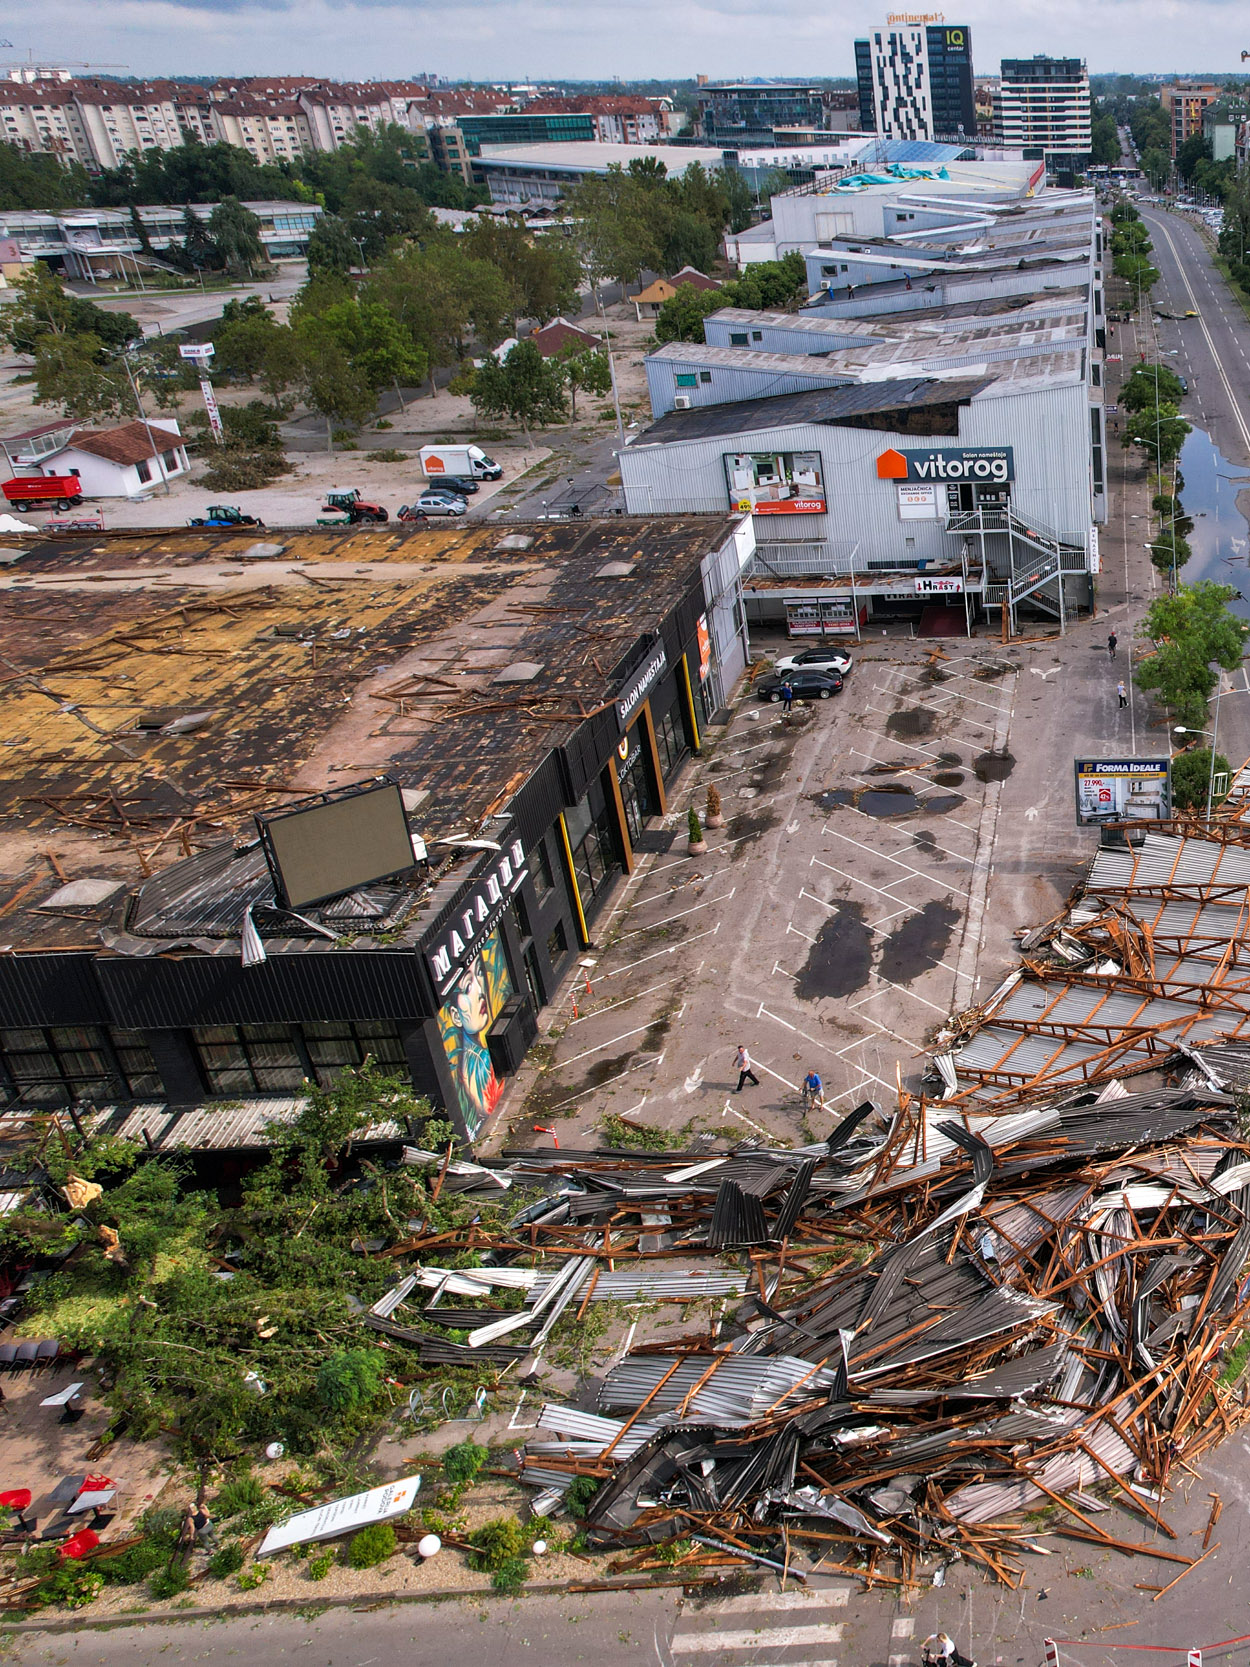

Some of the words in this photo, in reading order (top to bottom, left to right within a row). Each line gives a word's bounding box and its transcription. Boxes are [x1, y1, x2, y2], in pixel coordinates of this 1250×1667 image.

[946, 30, 964, 45] IQ
[914, 454, 1008, 482] vitorog
[794, 501, 821, 510] vitorog
[922, 580, 954, 591] HRAST
[621, 686, 638, 719] SALON
[637, 651, 666, 695] NAMEŠTAJA
[1096, 763, 1128, 772] FORMA
[1130, 763, 1160, 772] IDEALE
